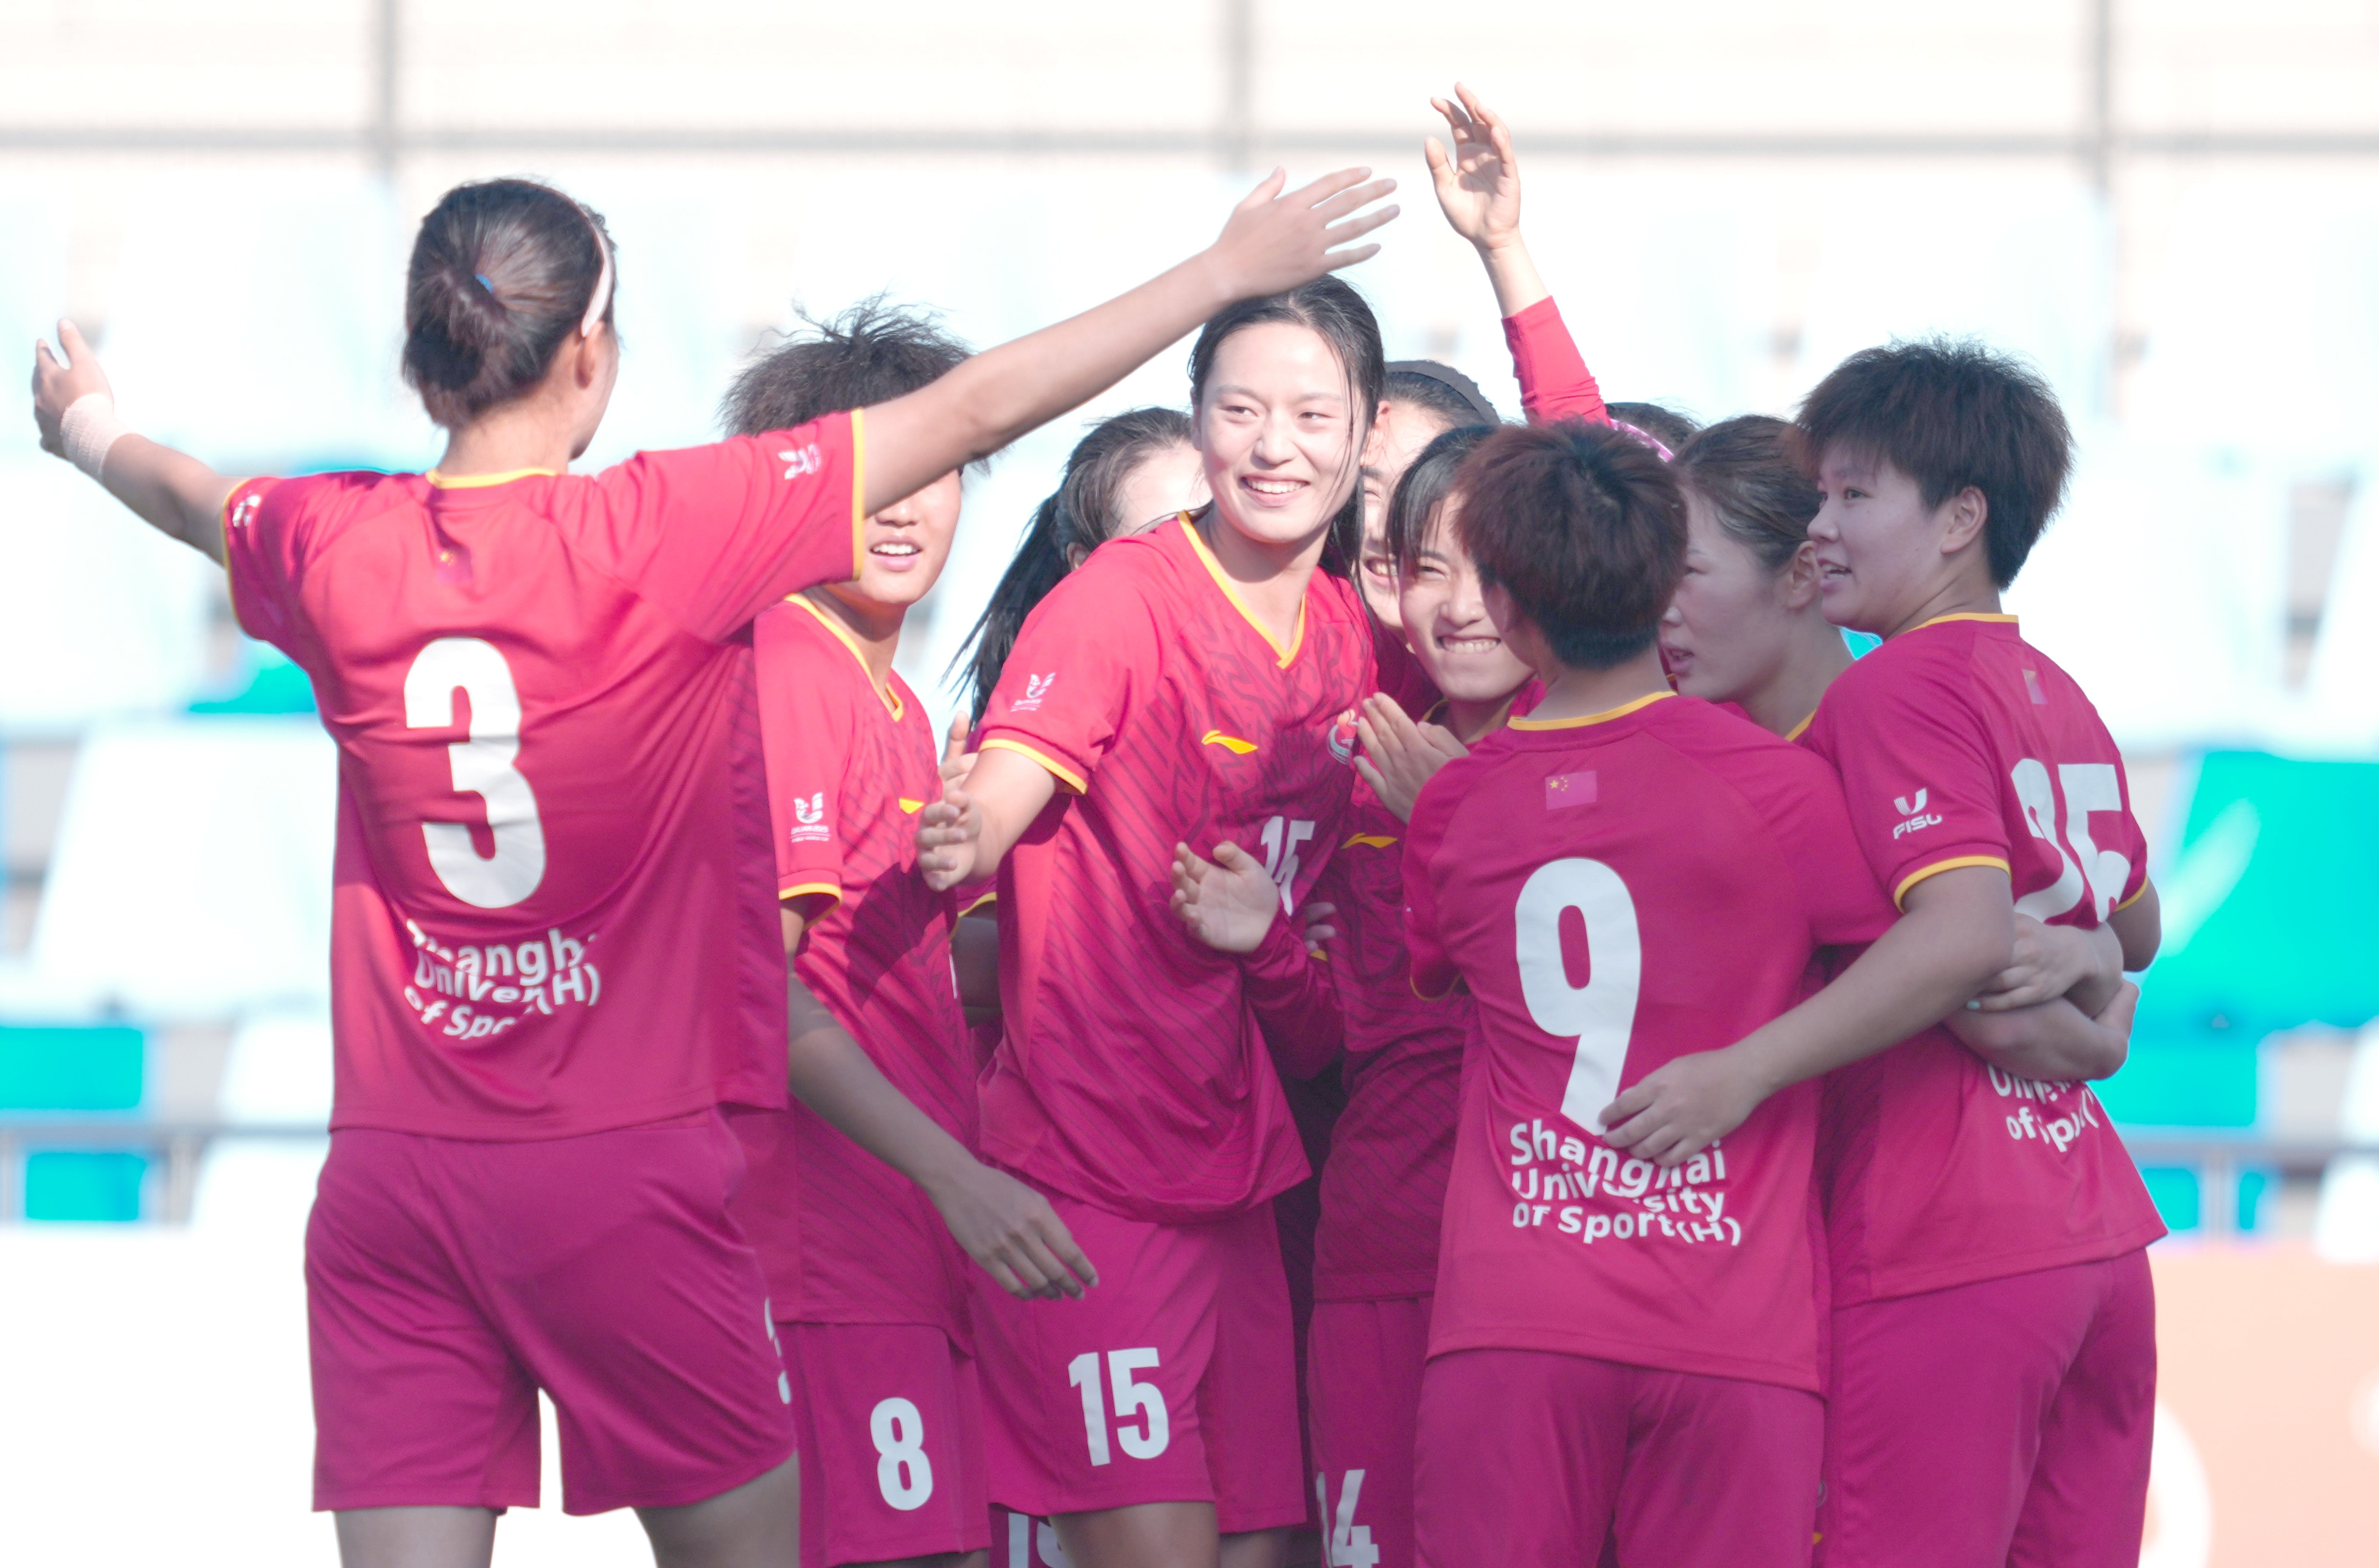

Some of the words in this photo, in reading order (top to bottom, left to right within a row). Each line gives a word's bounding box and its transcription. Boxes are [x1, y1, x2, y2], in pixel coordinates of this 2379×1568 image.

[404, 636, 546, 908] 3
[1893, 814, 1943, 840] FISU
[1515, 856, 1642, 1137] 9
[2006, 1106, 2037, 1140] of
[870, 1397, 933, 1511] 8
[1068, 1347, 1170, 1467] 15
